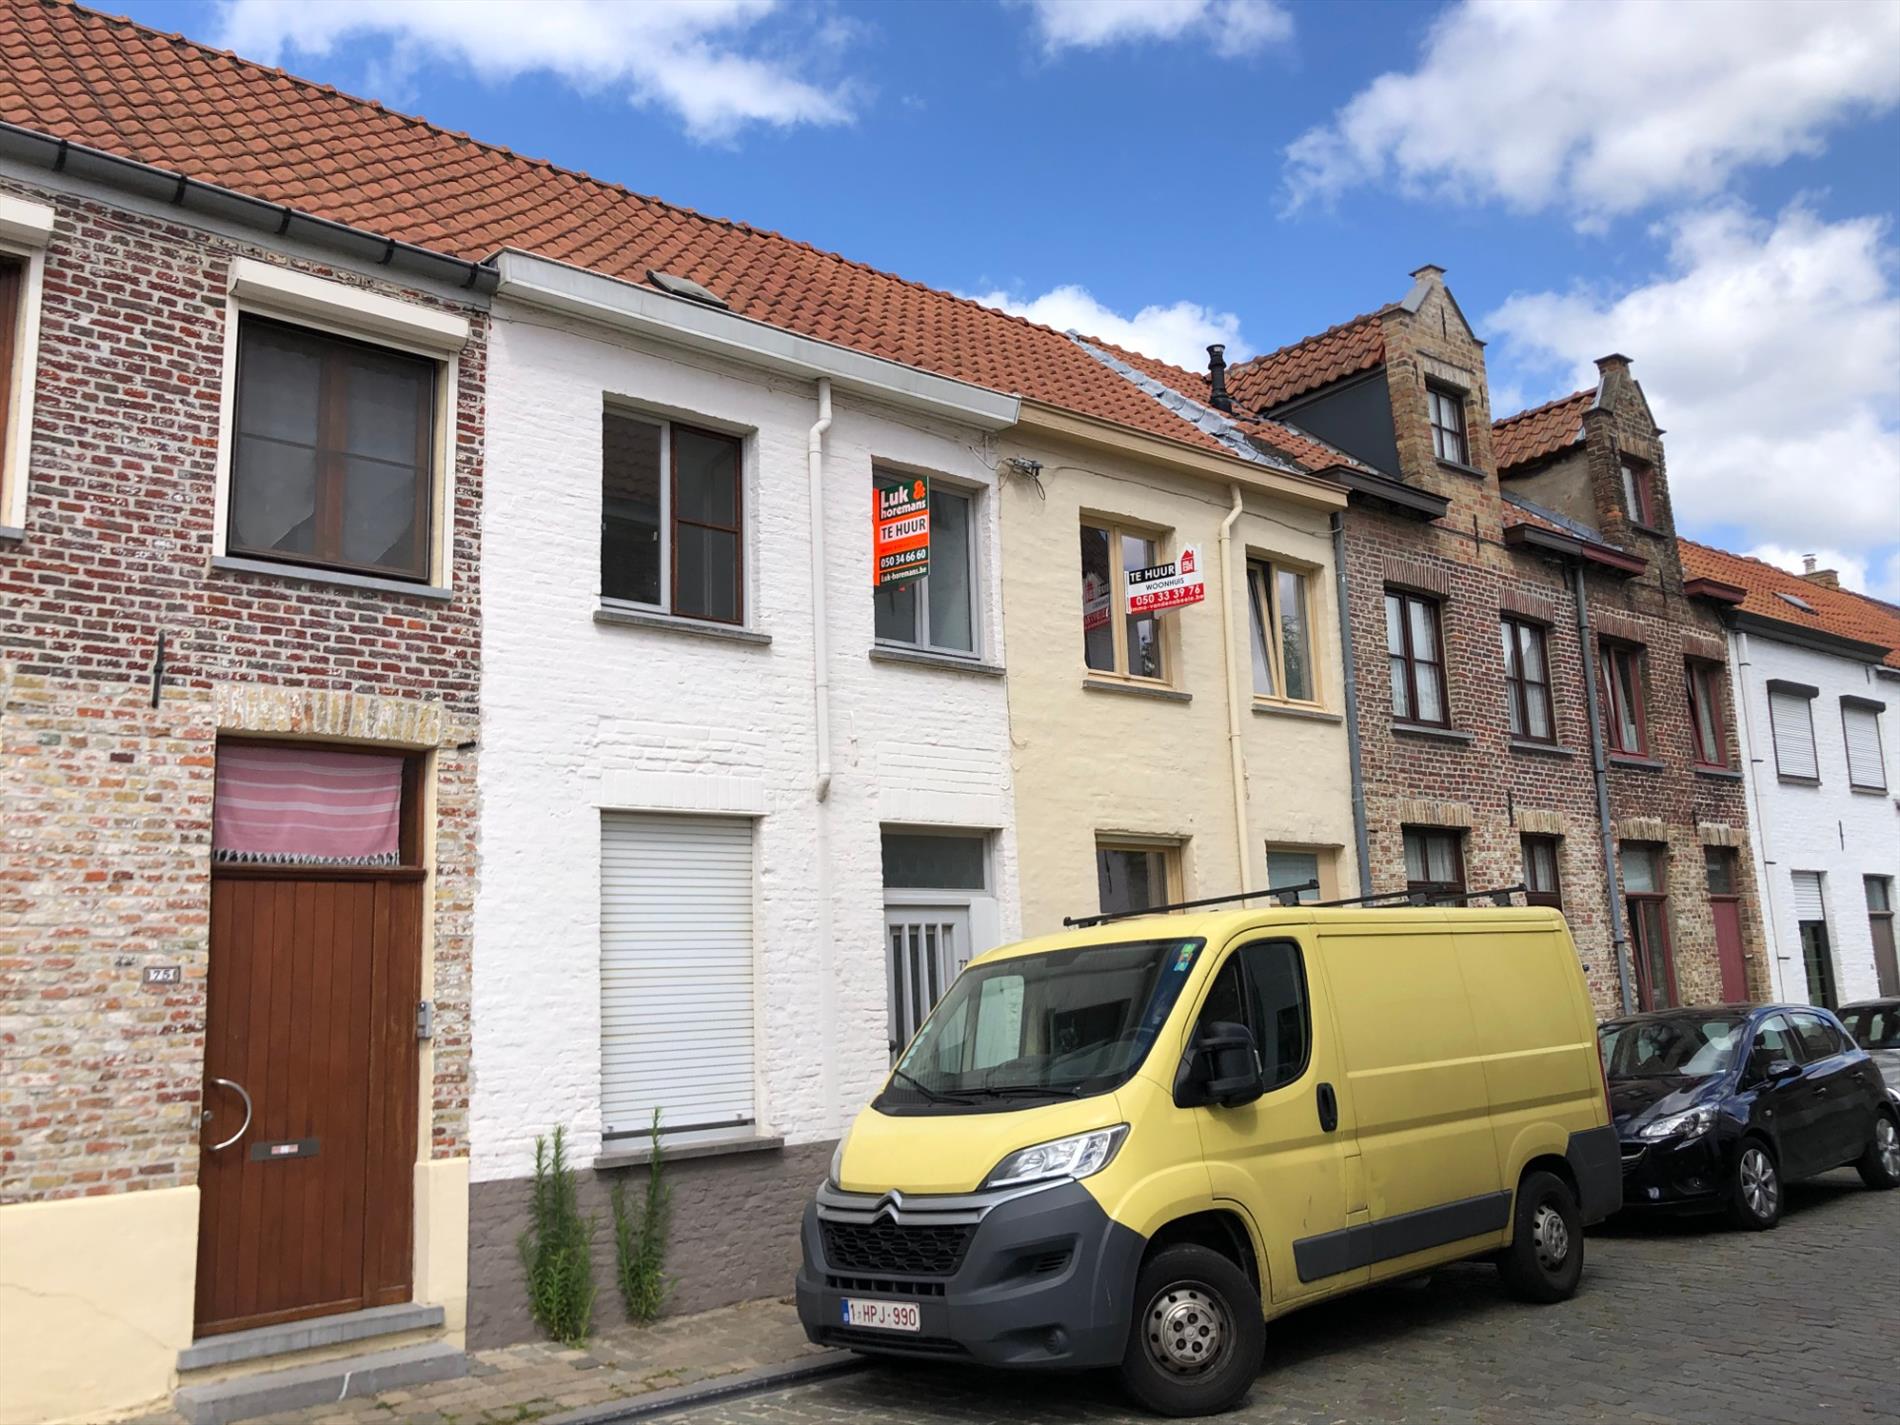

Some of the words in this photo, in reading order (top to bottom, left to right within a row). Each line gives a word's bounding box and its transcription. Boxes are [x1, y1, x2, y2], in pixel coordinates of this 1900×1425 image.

[881, 486, 908, 508] Luk
[913, 480, 925, 499] &
[881, 500, 925, 519] horemans
[882, 526, 893, 539] TE
[896, 518, 926, 536] HUUR
[881, 556, 894, 567] 050
[895, 554, 904, 565] 34
[906, 551, 915, 561] 66
[917, 549, 926, 559] 60
[1130, 572, 1141, 582] TE
[1145, 564, 1175, 579] HUUR
[1146, 578, 1184, 590] WOONHUIS
[1136, 594, 1155, 605] 050
[1158, 591, 1170, 602] 33
[1173, 588, 1184, 599] 39
[1188, 585, 1200, 595] 76
